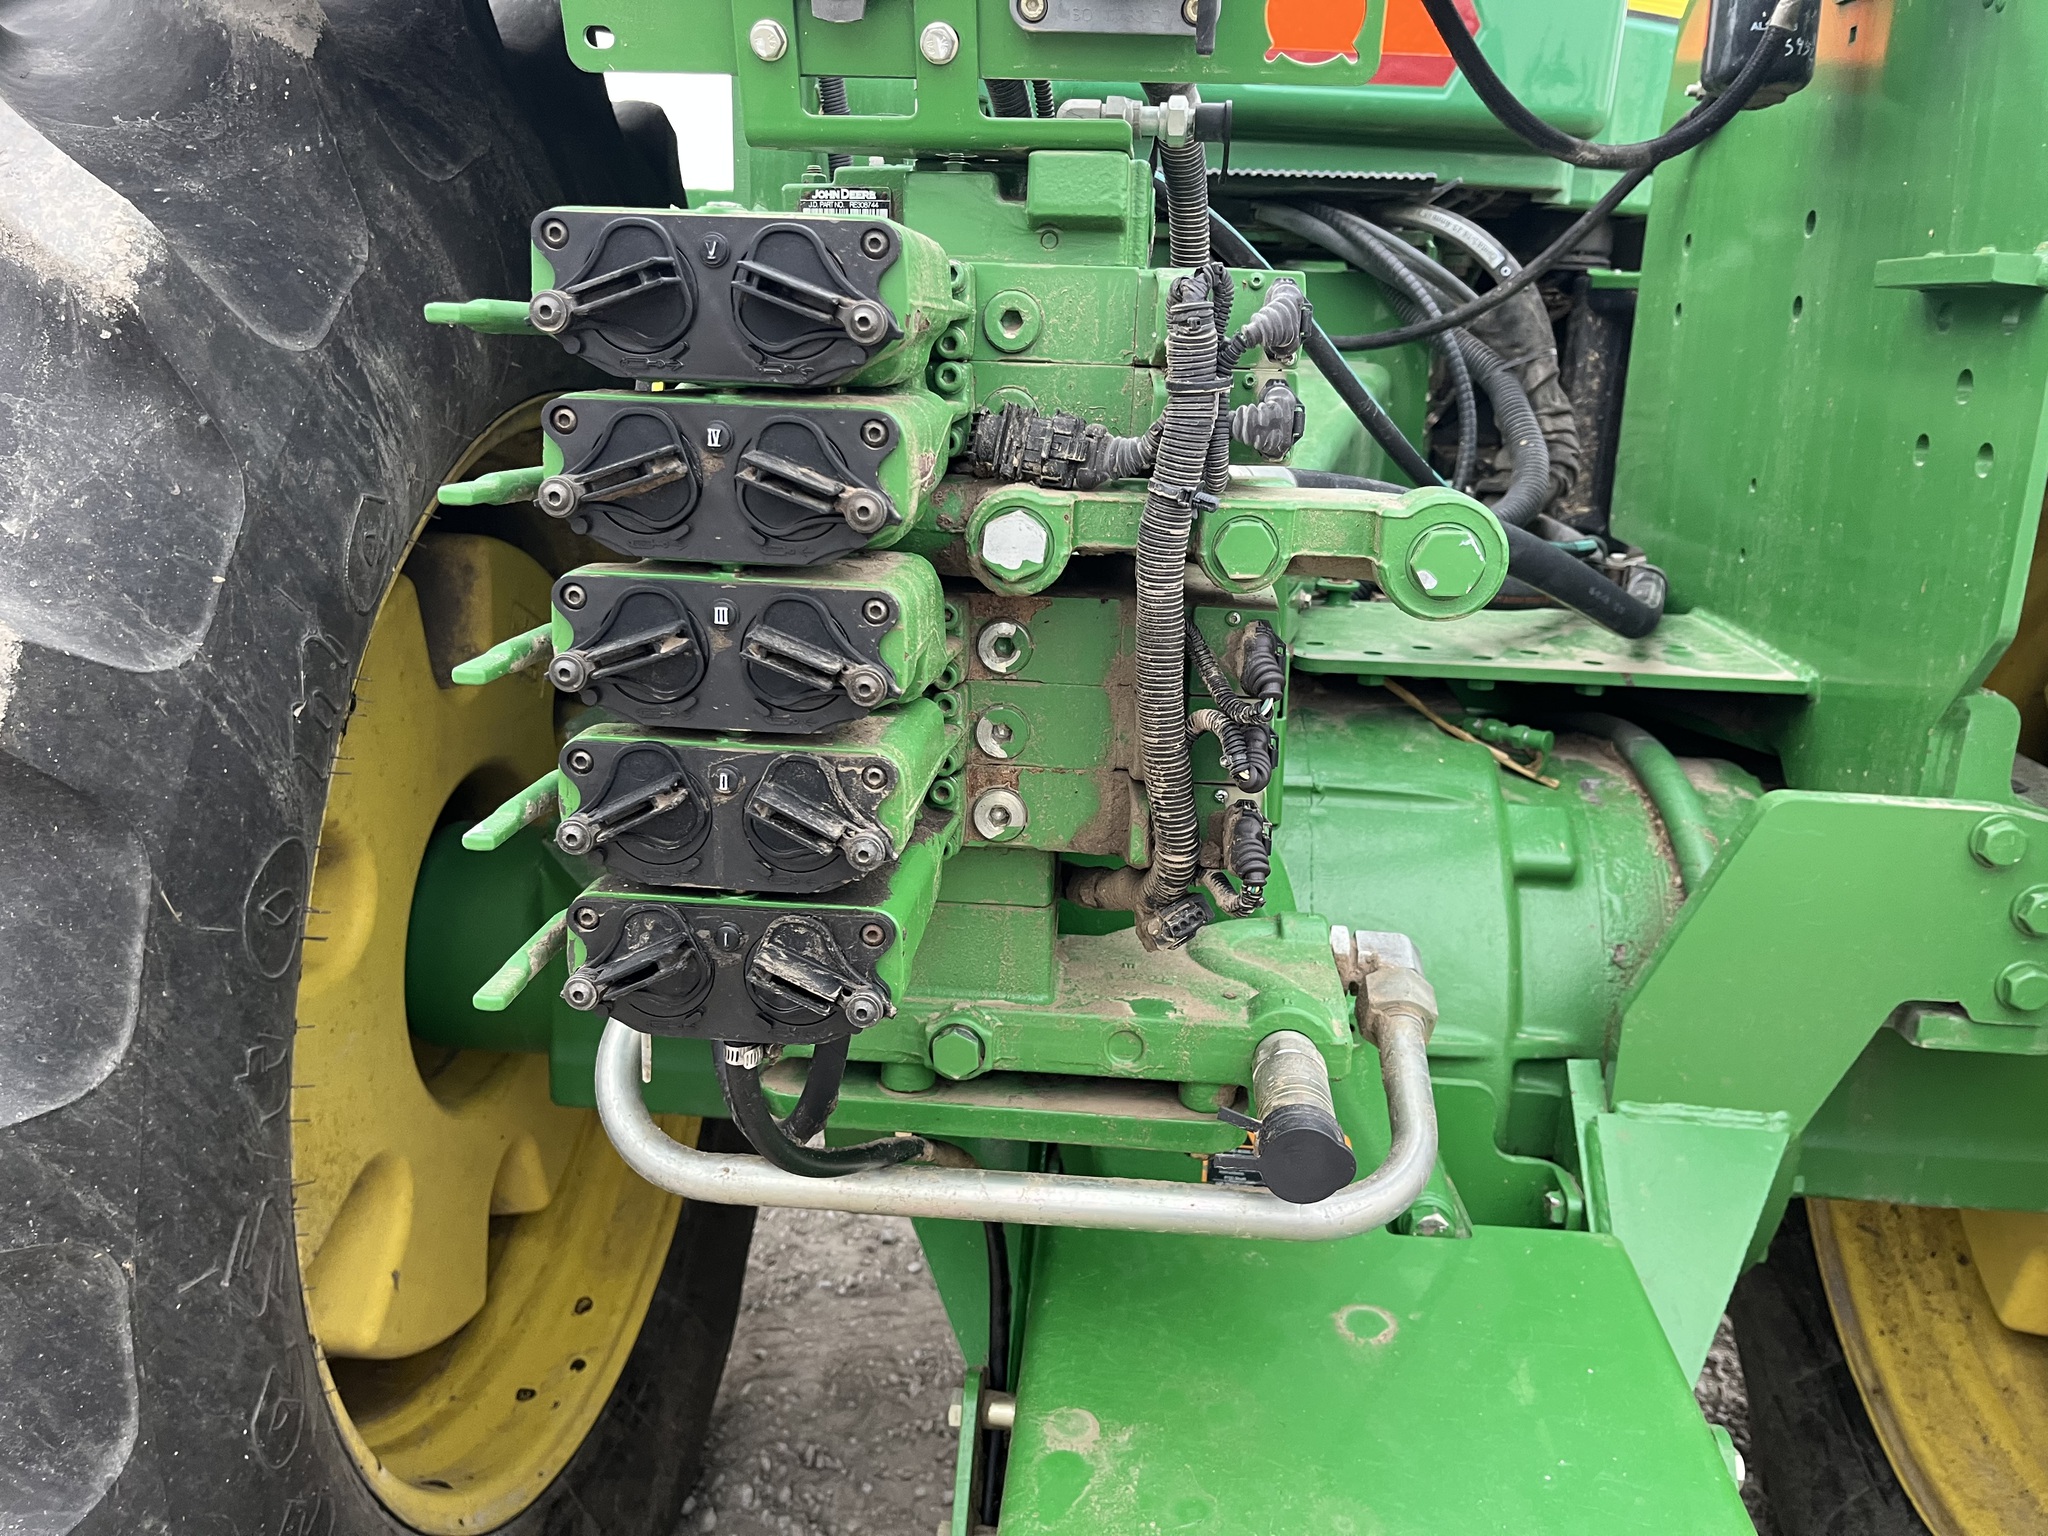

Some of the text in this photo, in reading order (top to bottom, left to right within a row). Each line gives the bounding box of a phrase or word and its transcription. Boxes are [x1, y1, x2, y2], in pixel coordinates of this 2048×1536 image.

[811, 188, 877, 199] JOHN DEERE
[704, 240, 717, 259] V
[707, 428, 721, 447] IV
[713, 606, 729, 625] III
